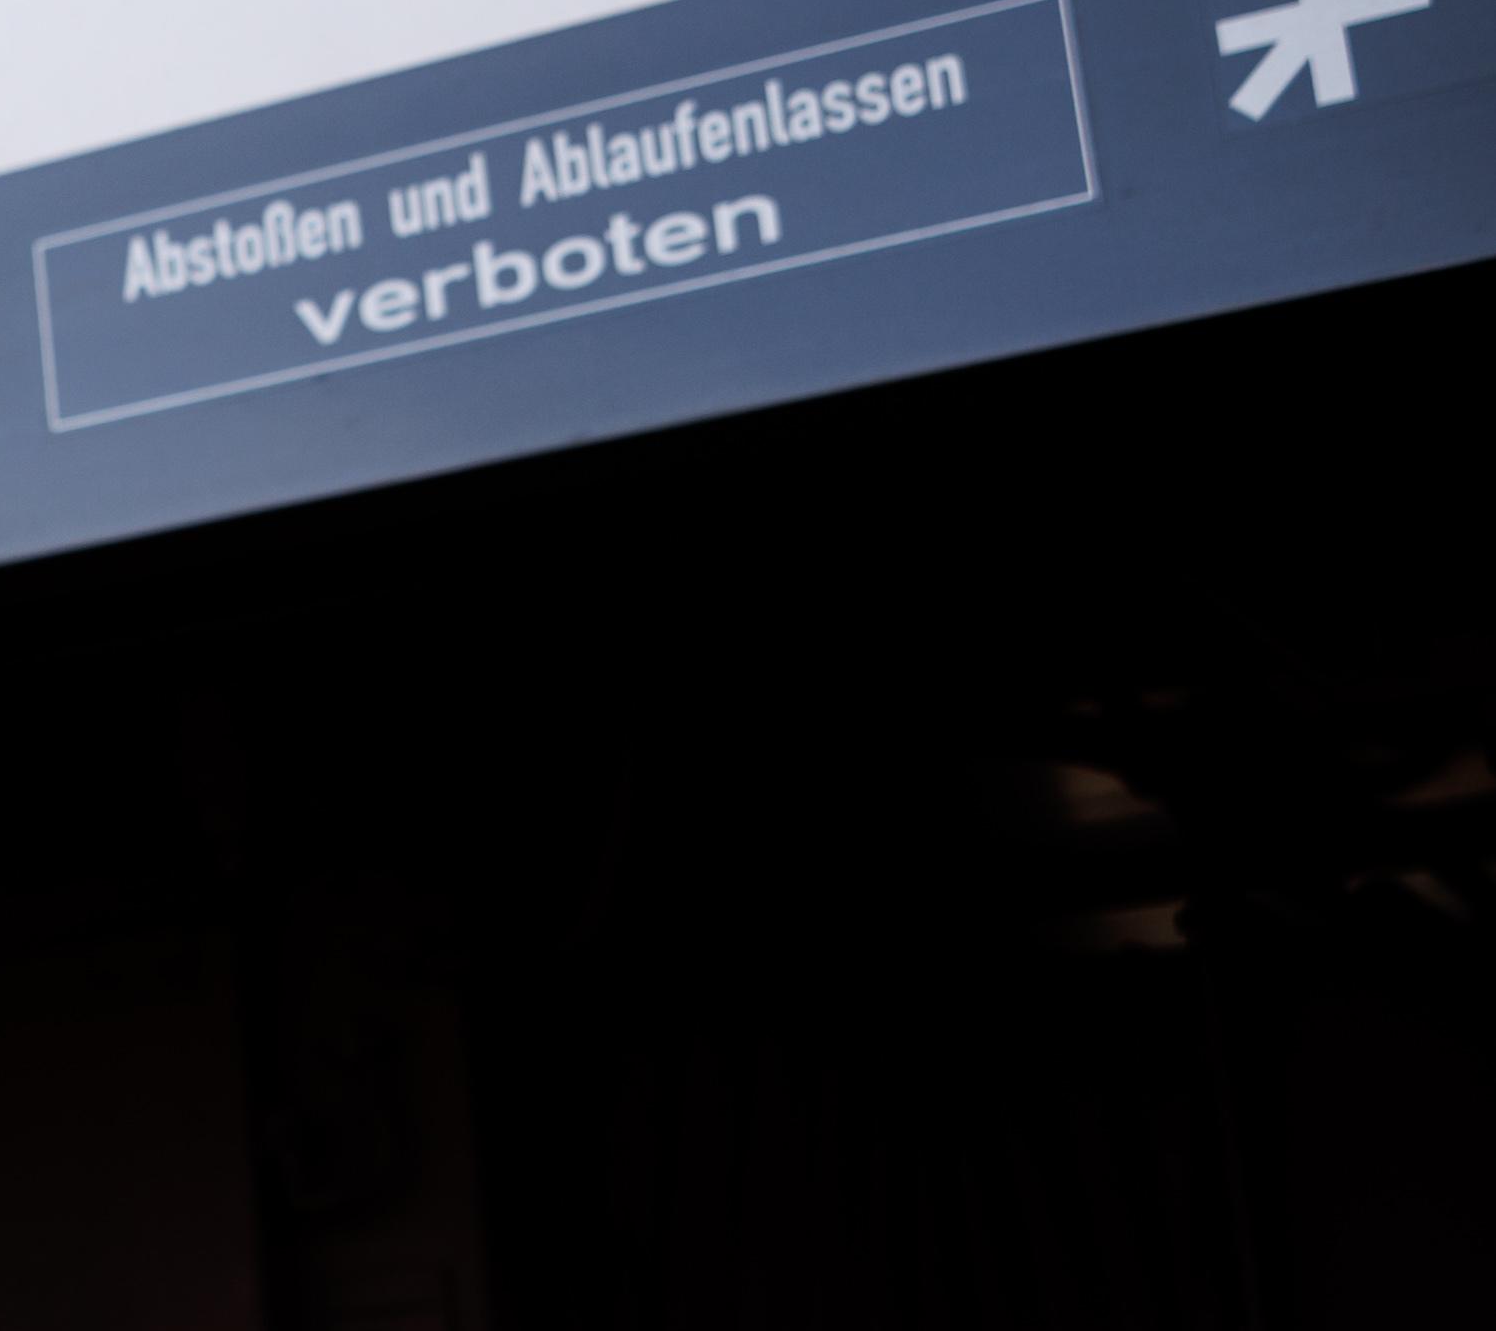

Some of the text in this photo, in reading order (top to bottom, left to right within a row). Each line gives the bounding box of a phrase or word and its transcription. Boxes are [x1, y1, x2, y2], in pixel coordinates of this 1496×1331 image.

[121, 53, 968, 304] Abstoßen und Ablaufenlassen
[293, 194, 782, 346] verboten
